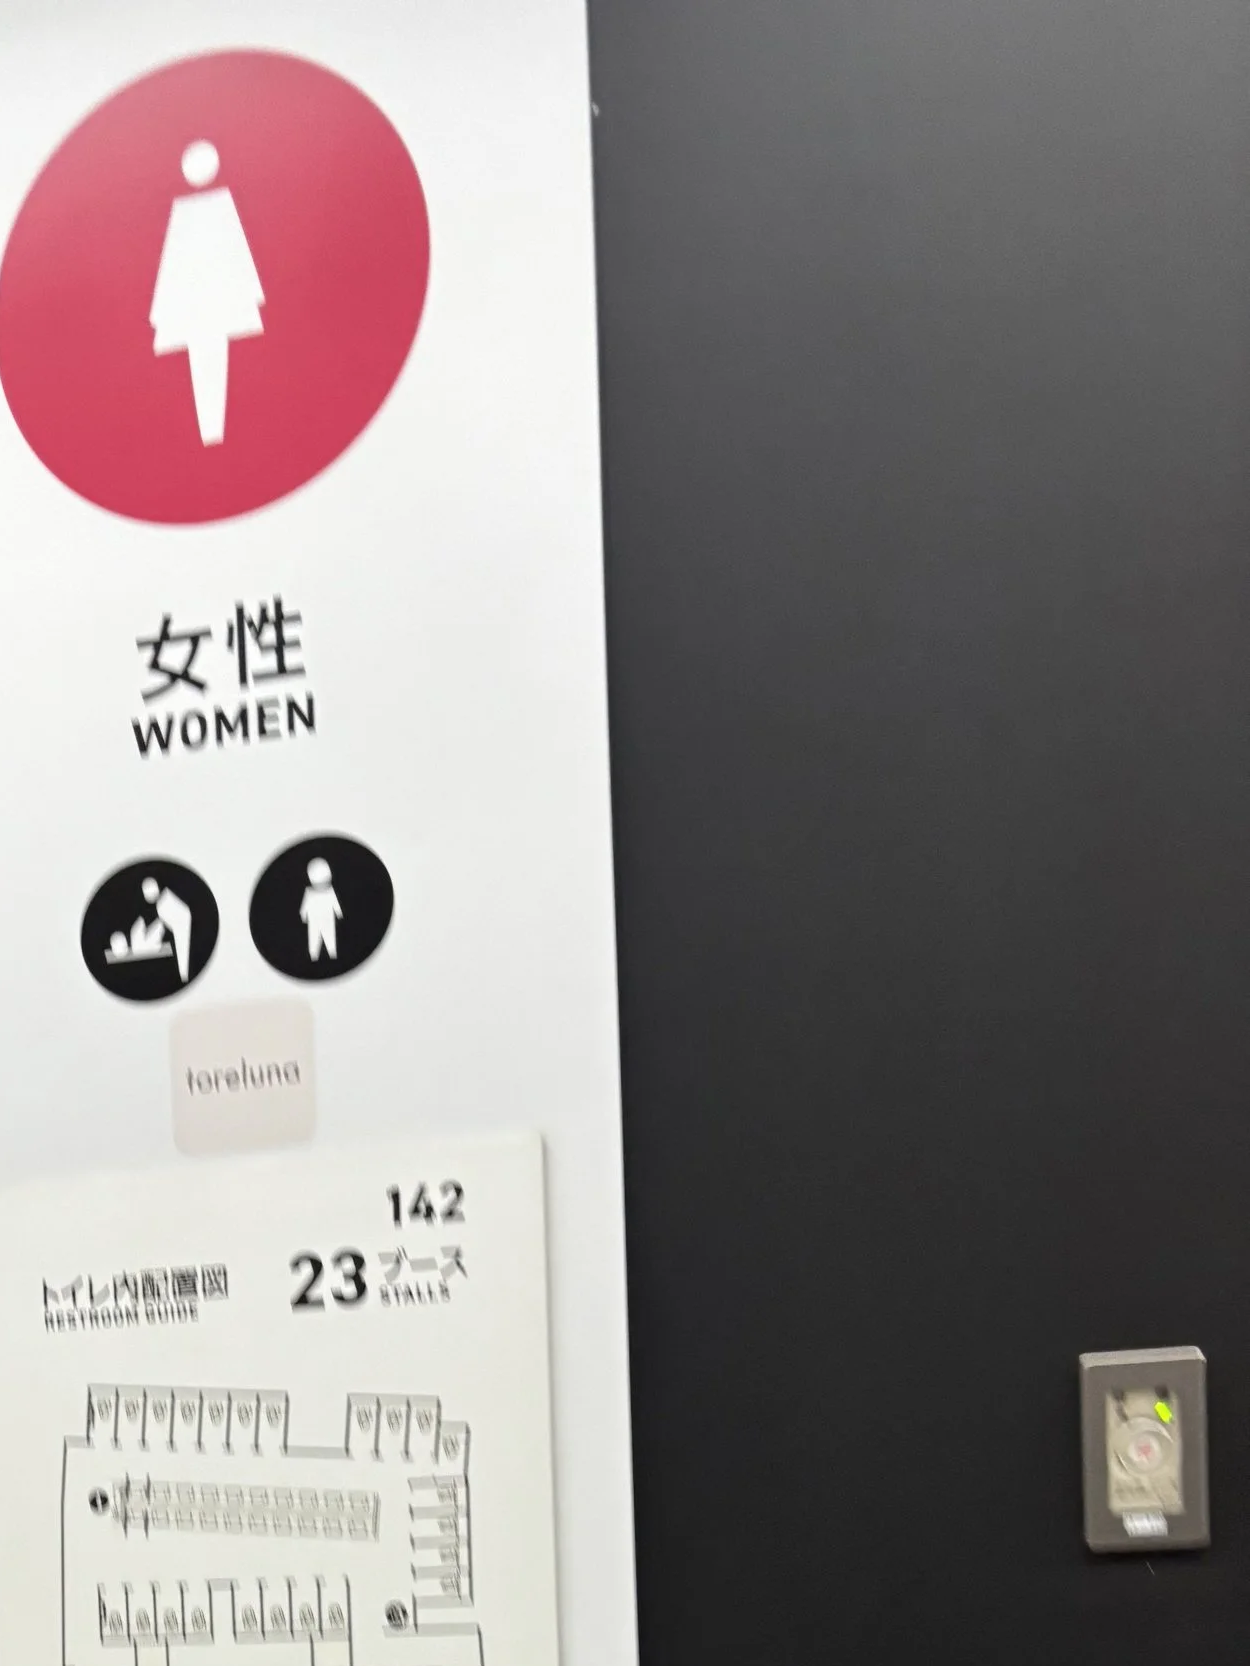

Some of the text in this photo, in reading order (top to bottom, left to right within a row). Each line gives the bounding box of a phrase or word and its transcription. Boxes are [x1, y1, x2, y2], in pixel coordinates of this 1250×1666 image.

[135, 593, 306, 705] 女性
[131, 691, 316, 759] WOMEN
[386, 1179, 466, 1229] 142
[42, 1263, 229, 1310] トイレ内配置図
[289, 1245, 468, 1313] 23 ブース
